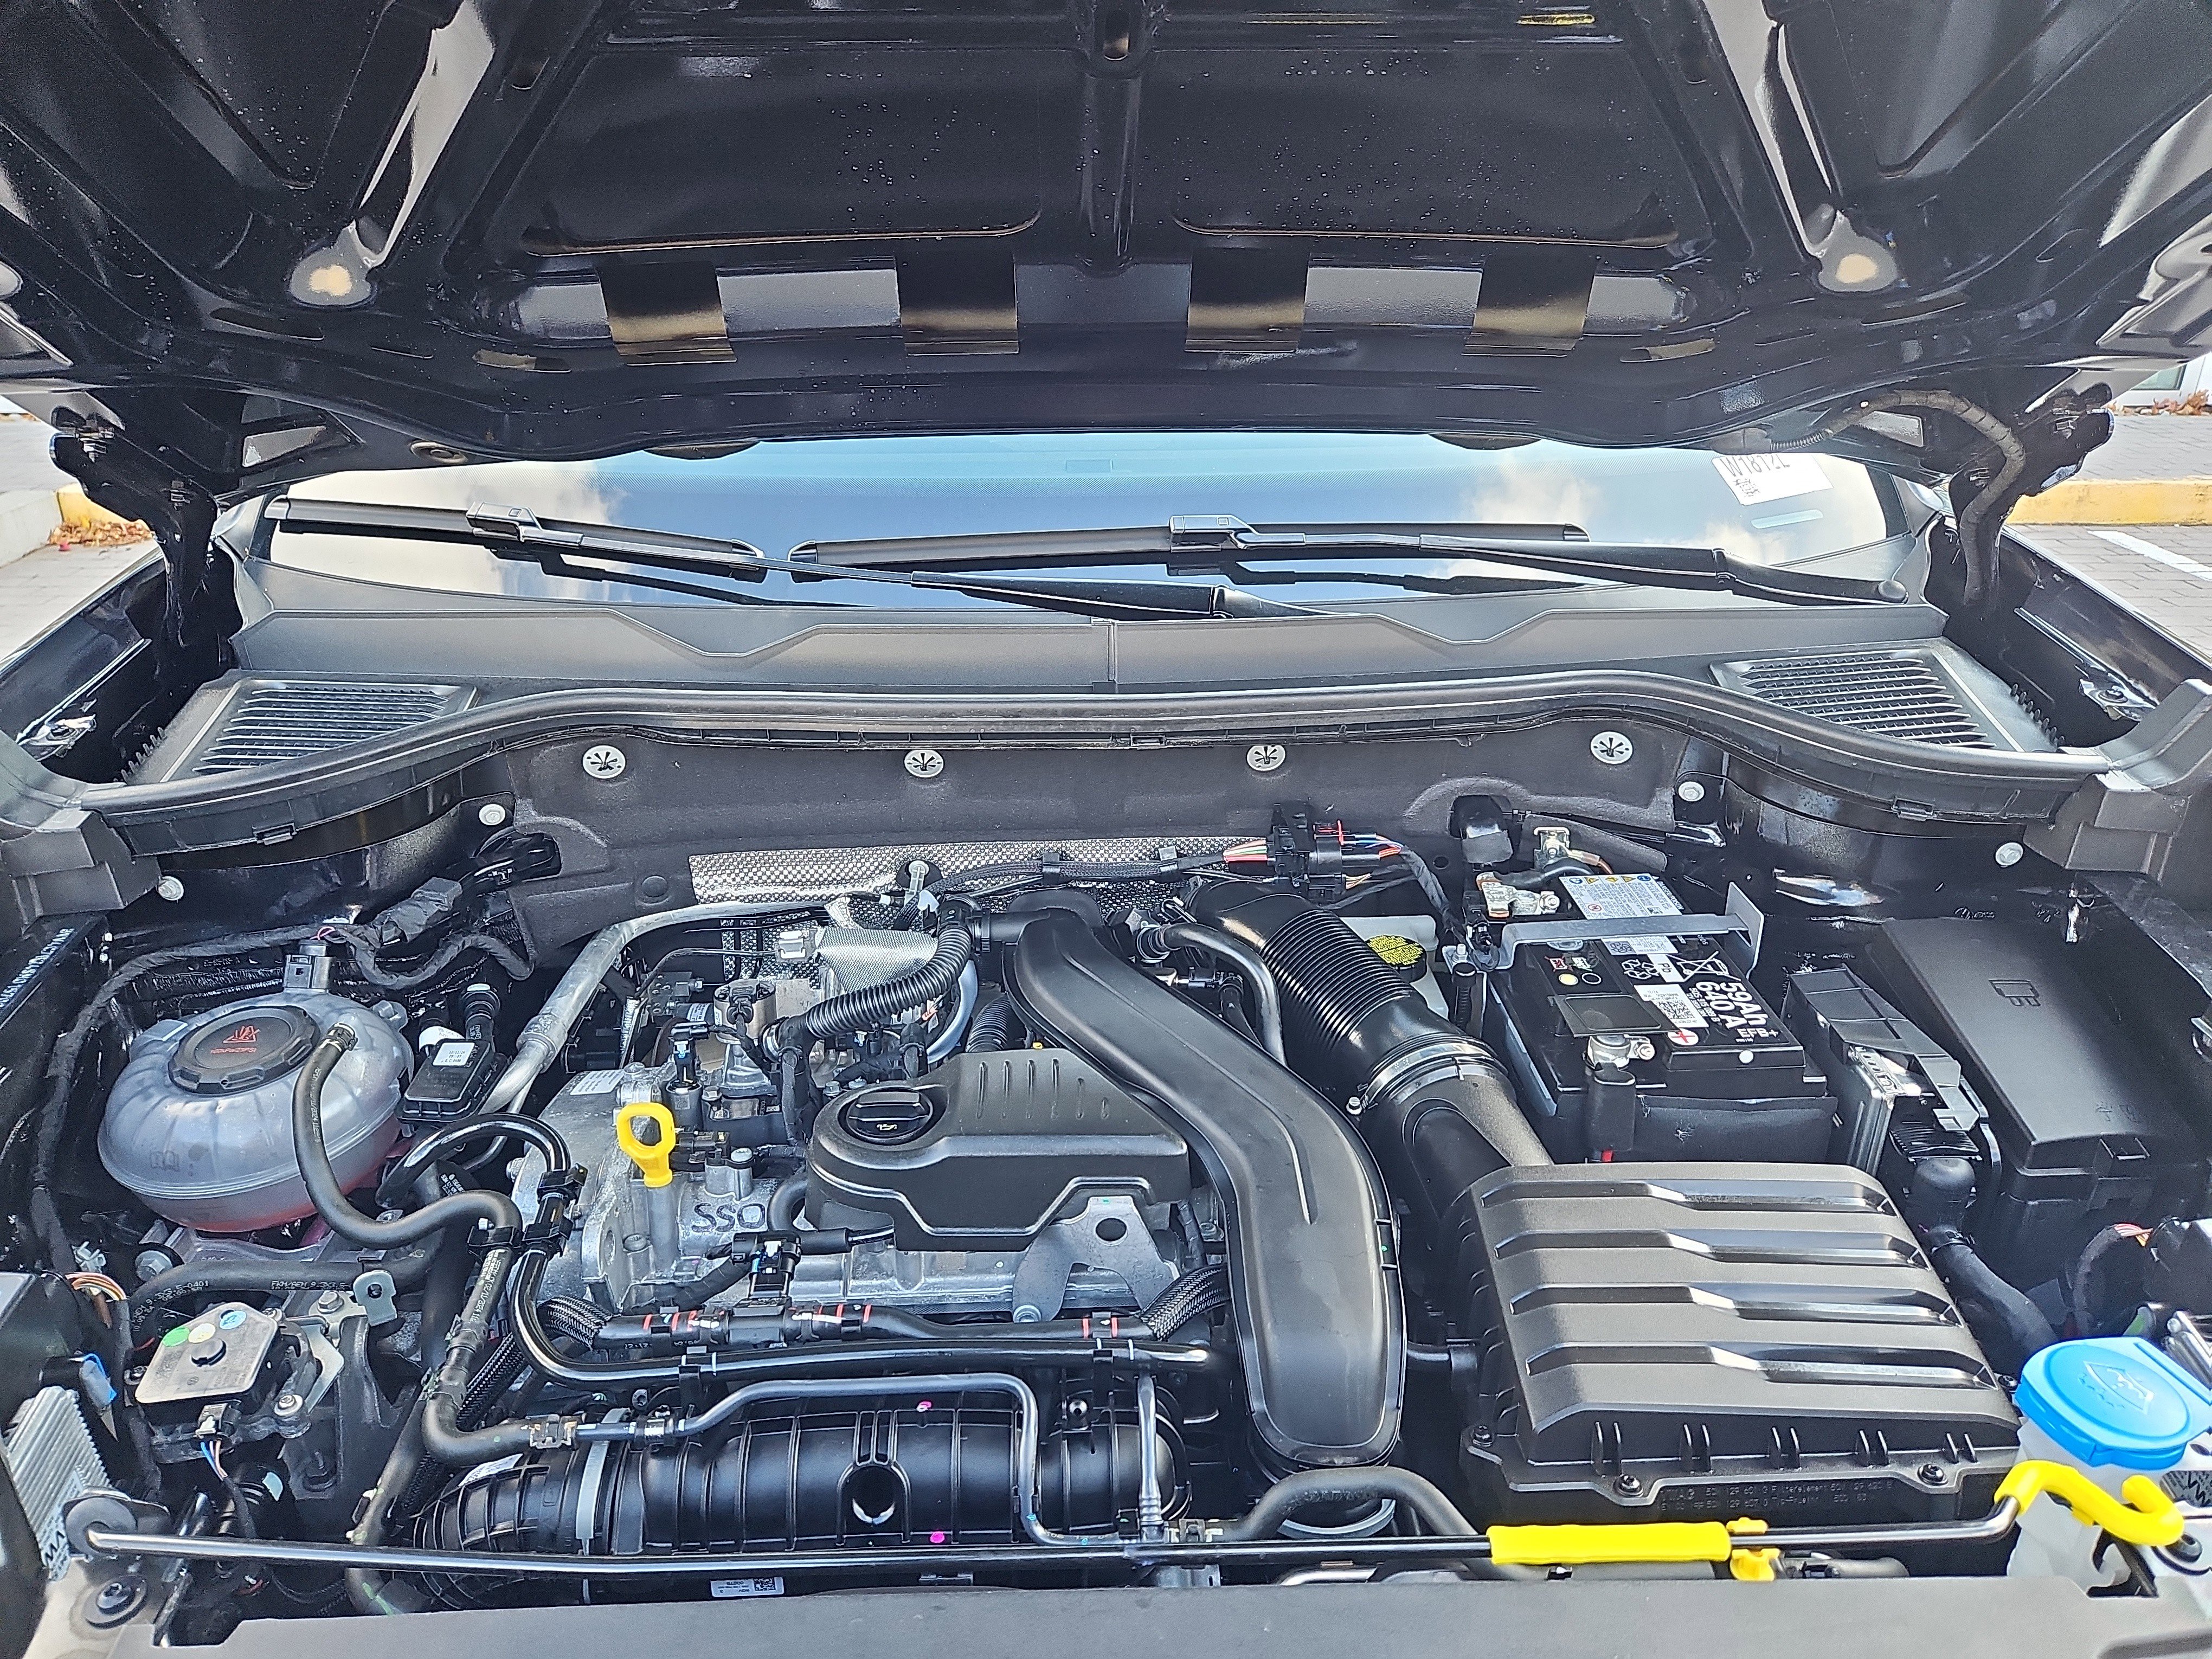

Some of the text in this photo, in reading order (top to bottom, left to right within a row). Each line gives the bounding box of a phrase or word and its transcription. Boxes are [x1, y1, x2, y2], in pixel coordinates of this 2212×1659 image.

[1657, 962, 1672, 974] Pb
[1695, 981, 1735, 1011] 640
[1718, 1013, 1747, 1030] A
[1720, 982, 1769, 1025] 59Ah
[1737, 1028, 1779, 1038] EFB+
